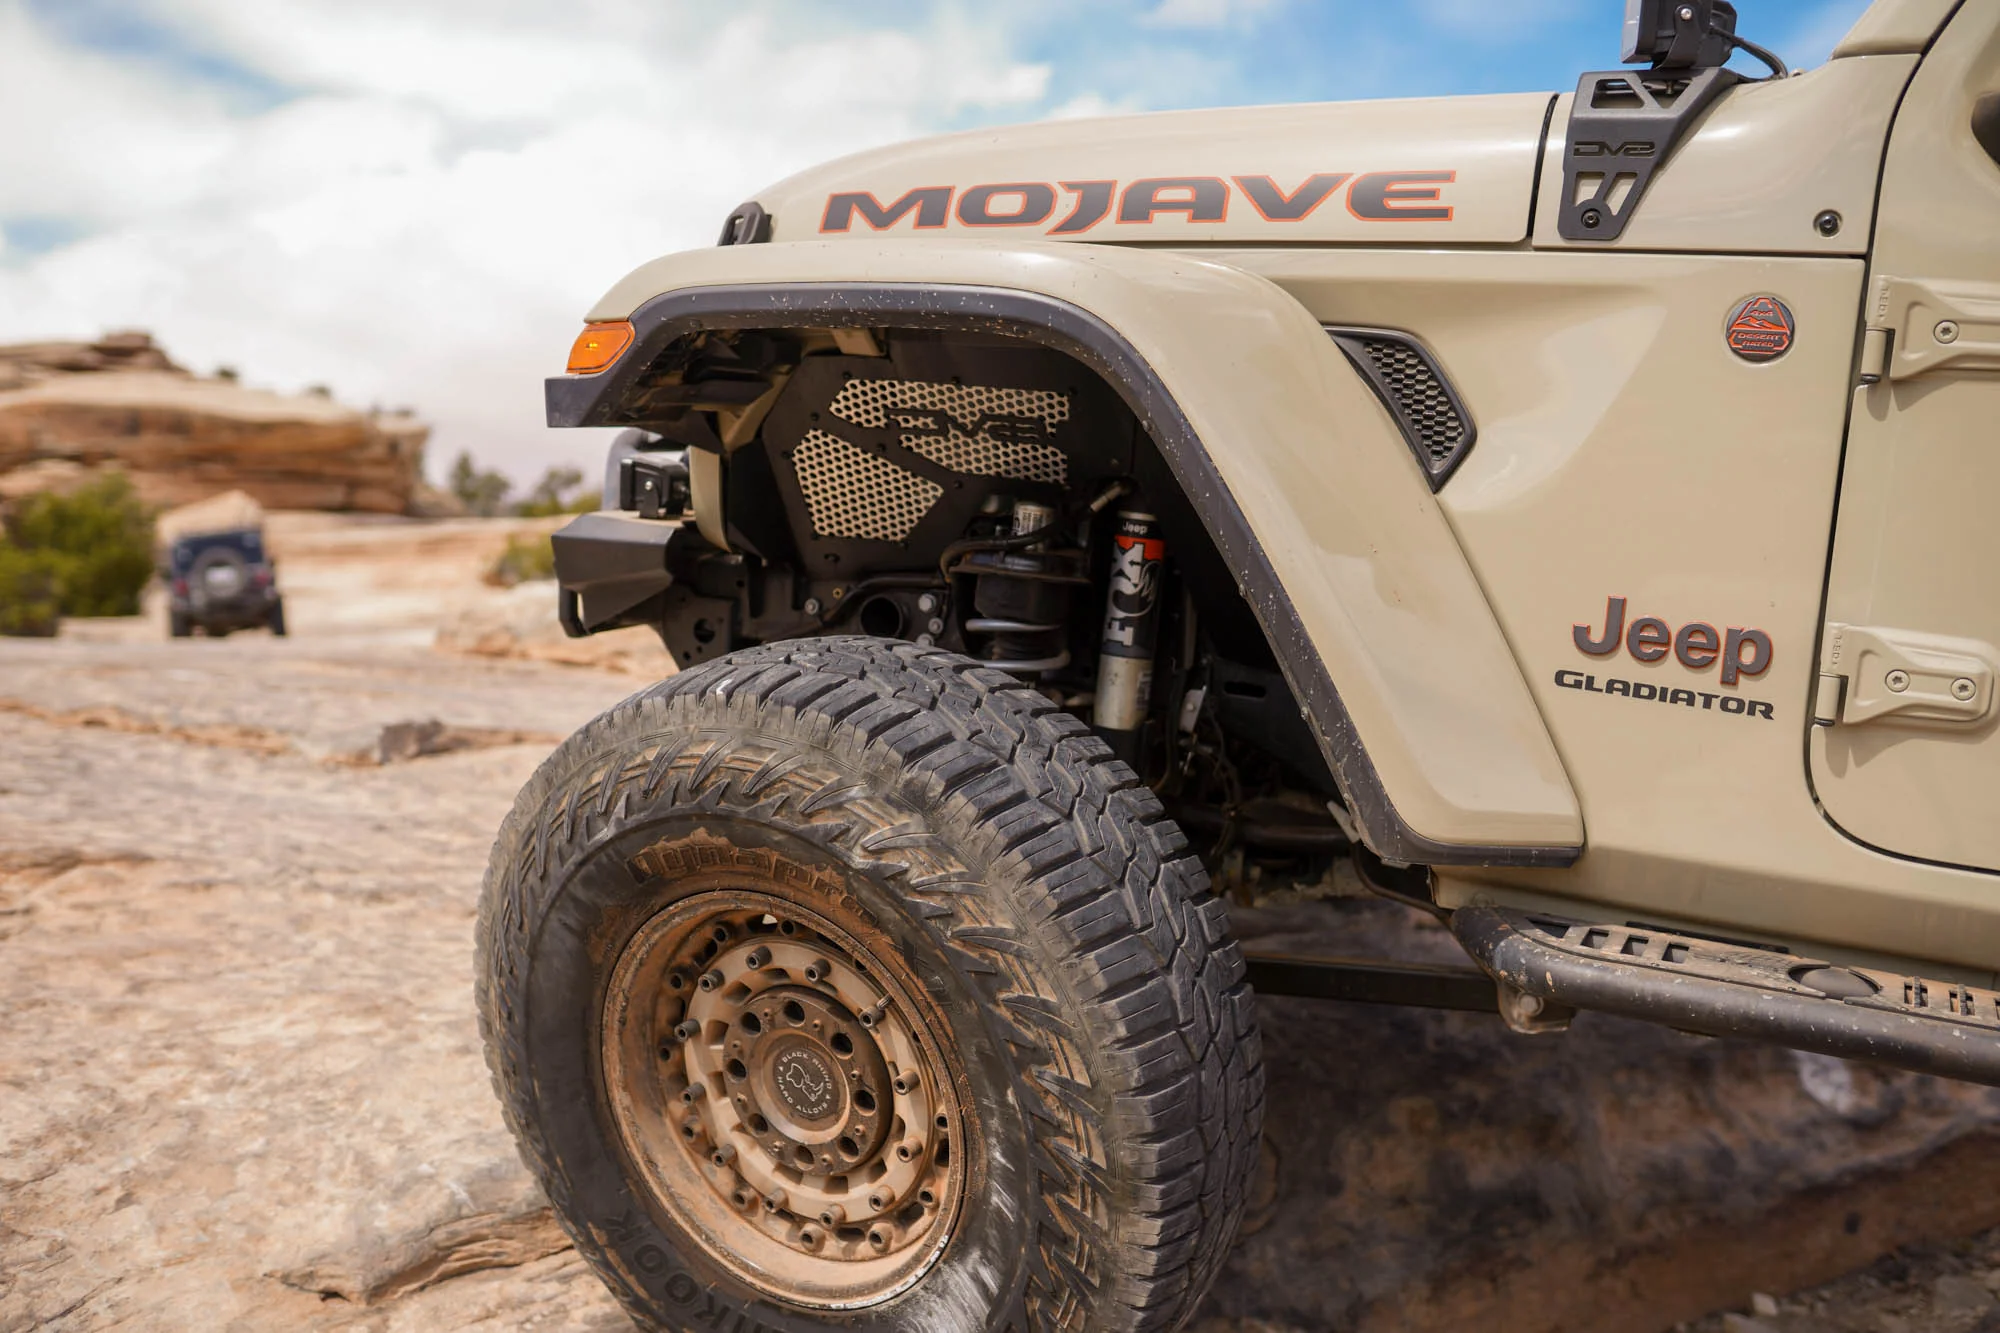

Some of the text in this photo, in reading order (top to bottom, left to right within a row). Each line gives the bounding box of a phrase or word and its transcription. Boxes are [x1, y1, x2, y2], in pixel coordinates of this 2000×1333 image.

[1573, 141, 1656, 157] DV8
[818, 170, 1457, 236] MOJAVE
[1122, 521, 1148, 535] Jeep
[1572, 595, 1774, 686] Jeep
[1554, 669, 1775, 720] GLADIATOR
[782, 1051, 832, 1089] BLACK RHINO
[777, 1076, 828, 1114] HARD ALLOYS
